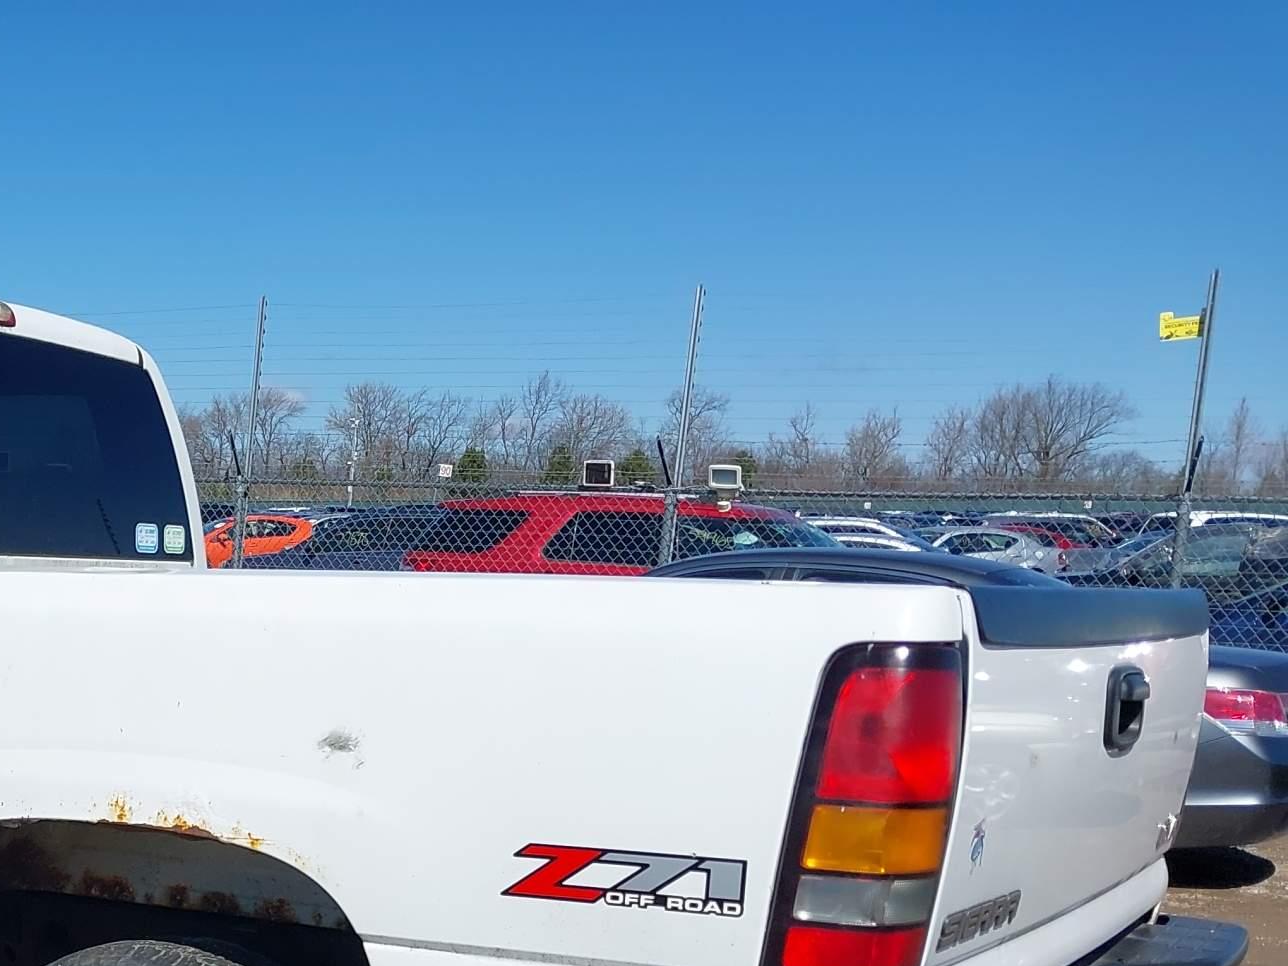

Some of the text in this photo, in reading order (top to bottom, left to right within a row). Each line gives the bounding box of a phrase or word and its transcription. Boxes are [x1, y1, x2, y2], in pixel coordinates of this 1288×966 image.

[501, 843, 748, 904] Z71
[604, 890, 743, 917] OFF ROAD
[935, 889, 1022, 954] SIERRA
